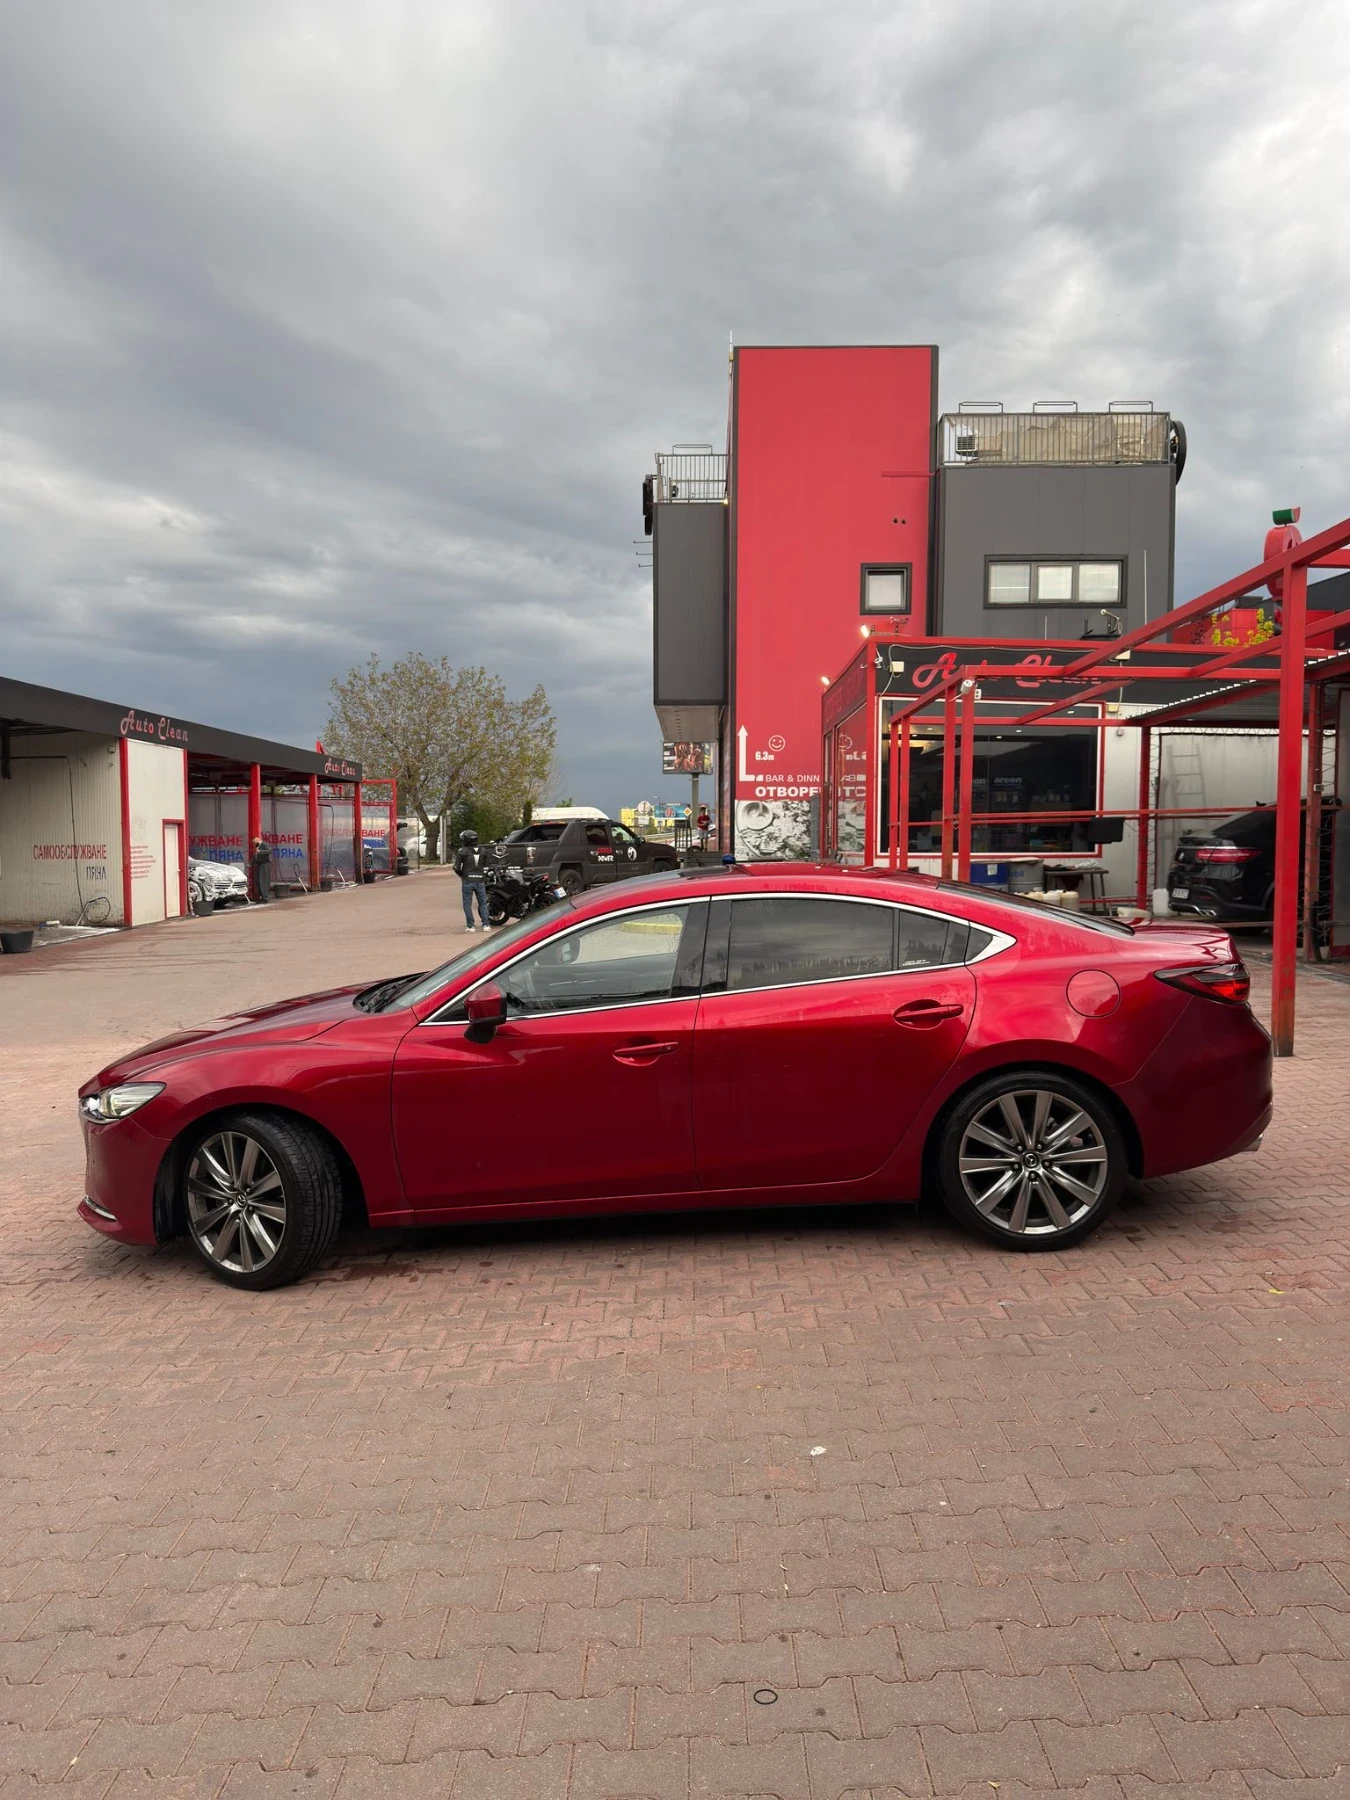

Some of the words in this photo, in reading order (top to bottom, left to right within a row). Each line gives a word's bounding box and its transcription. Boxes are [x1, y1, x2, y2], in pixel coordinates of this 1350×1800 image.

[120, 709, 154, 735] Auto
[158, 716, 189, 742] Clean
[324, 757, 341, 774] Auto
[341, 760, 356, 776] Clean
[765, 774, 785, 782] BAR
[786, 774, 795, 782] &
